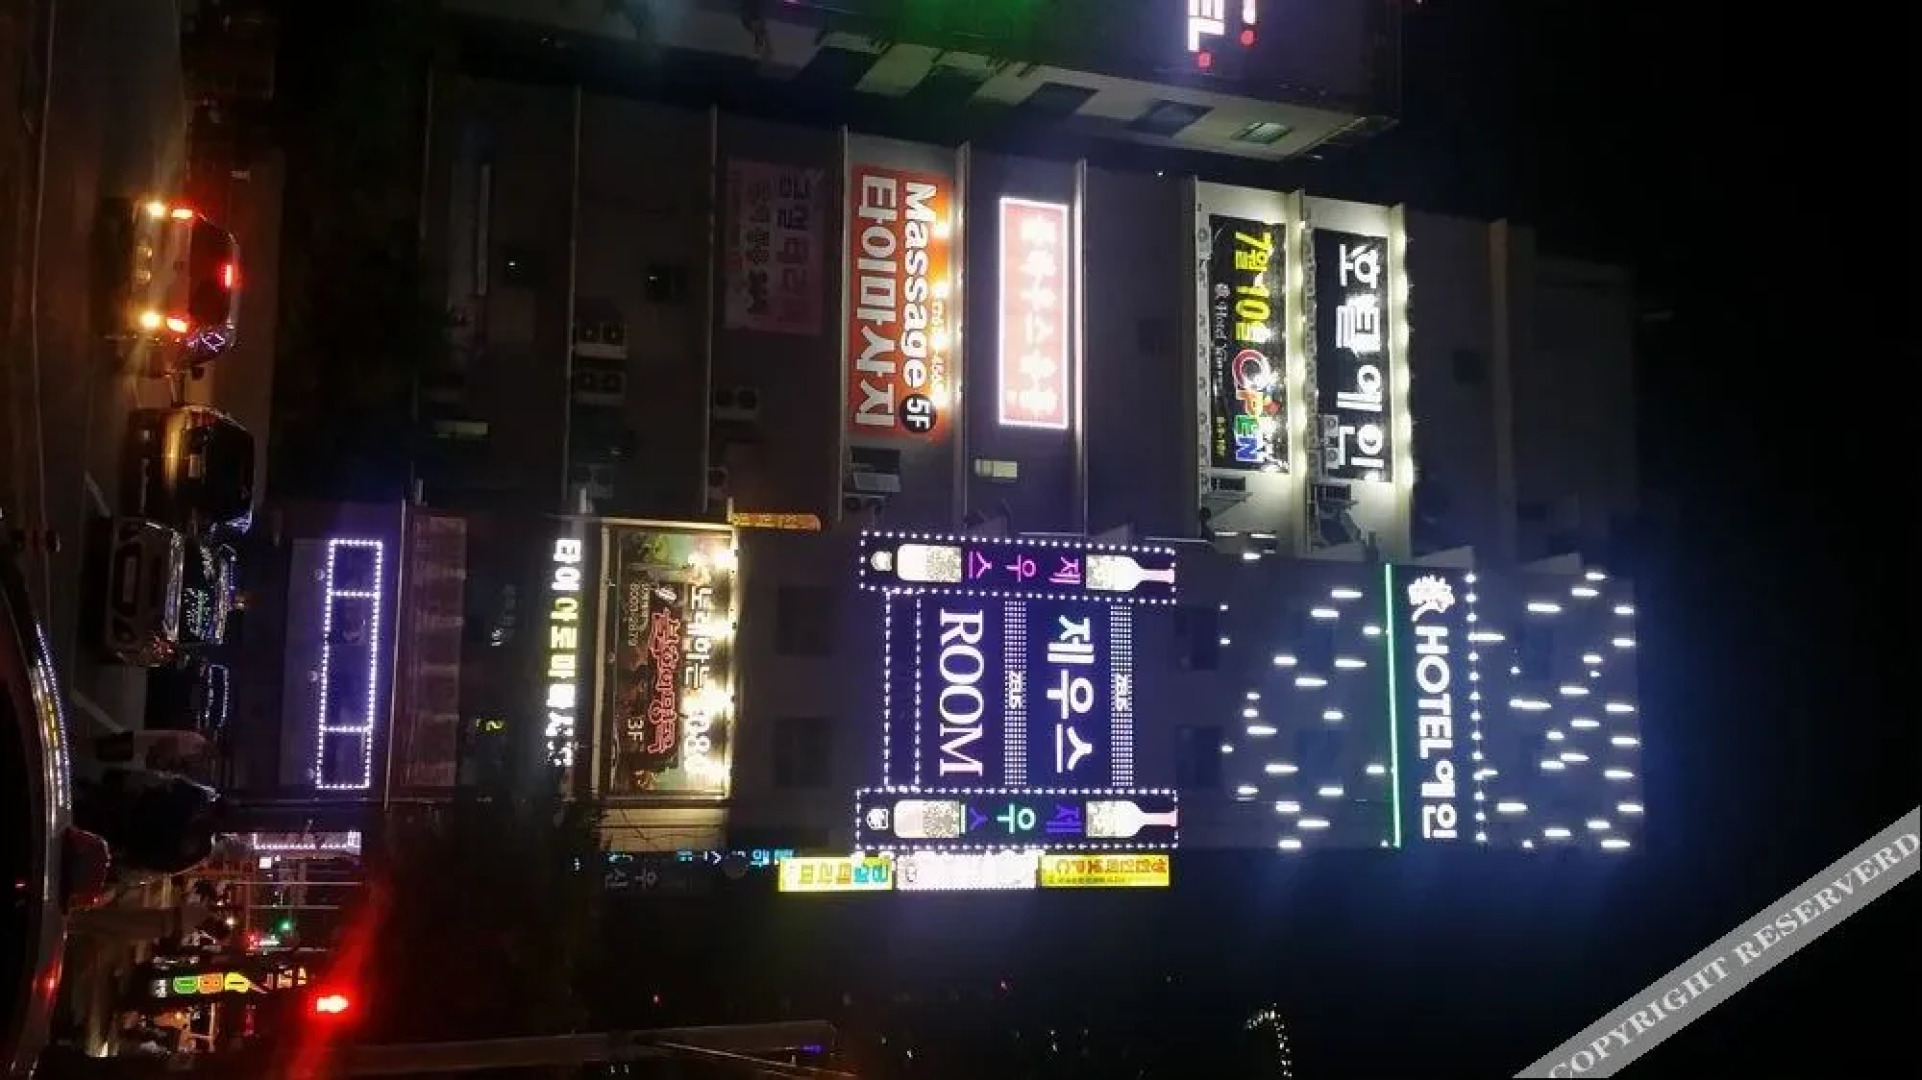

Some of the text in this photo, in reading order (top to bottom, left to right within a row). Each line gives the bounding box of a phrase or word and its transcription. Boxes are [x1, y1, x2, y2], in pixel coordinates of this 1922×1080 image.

[855, 175, 898, 427] 타이마사지
[901, 182, 937, 431] Massage 5F
[1231, 349, 1280, 463] OPEN
[968, 551, 1081, 585] 제우스
[684, 585, 713, 690] 노래하는
[1008, 670, 1023, 709] ZEUS
[627, 717, 644, 742] 3F
[939, 608, 985, 777] ROOM
[1046, 615, 1095, 773] 제우스
[1115, 674, 1129, 711] ZEUS
[1415, 626, 1454, 759] HOTEL
[960, 803, 1082, 834] 제우스
